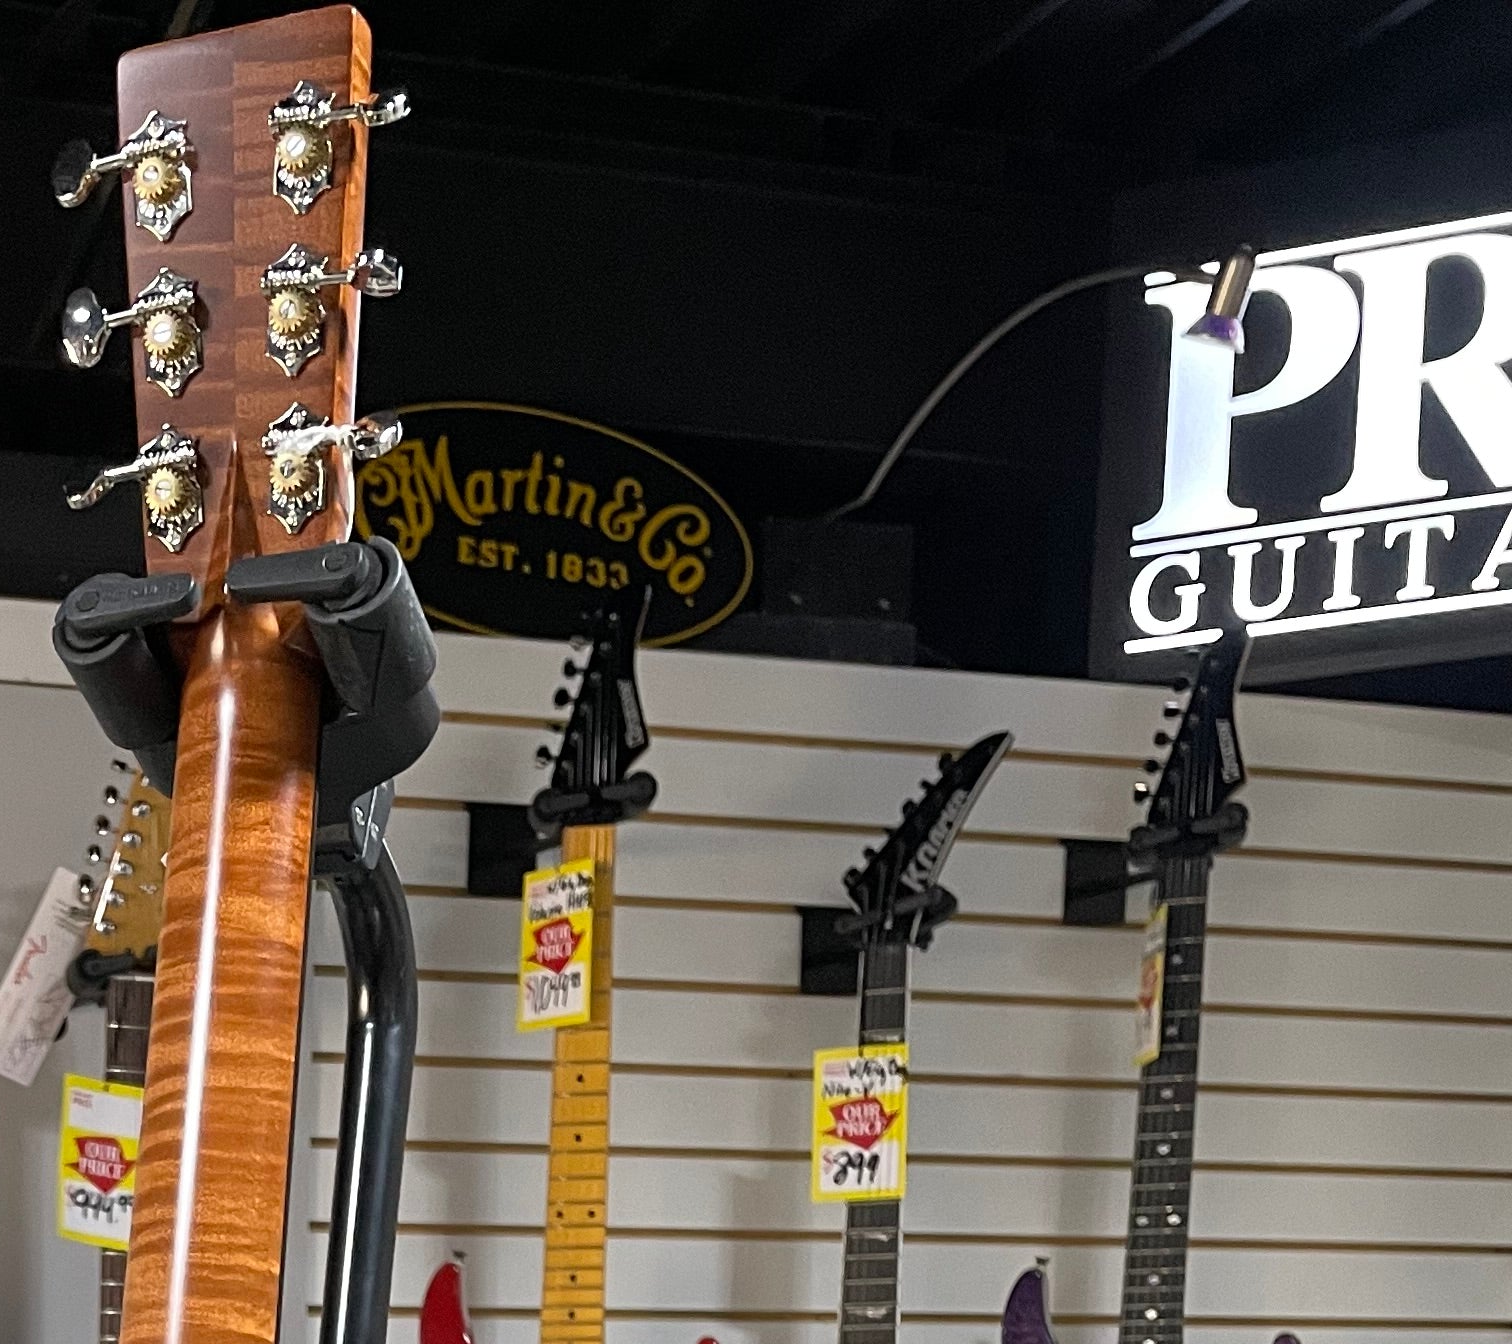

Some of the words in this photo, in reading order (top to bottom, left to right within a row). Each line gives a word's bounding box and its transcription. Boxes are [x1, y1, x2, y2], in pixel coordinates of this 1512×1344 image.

[456, 534, 532, 576] EST.
[841, 1103, 881, 1122] OUR
[836, 1118, 888, 1138] PRICE
[84, 1141, 122, 1162] OUR
